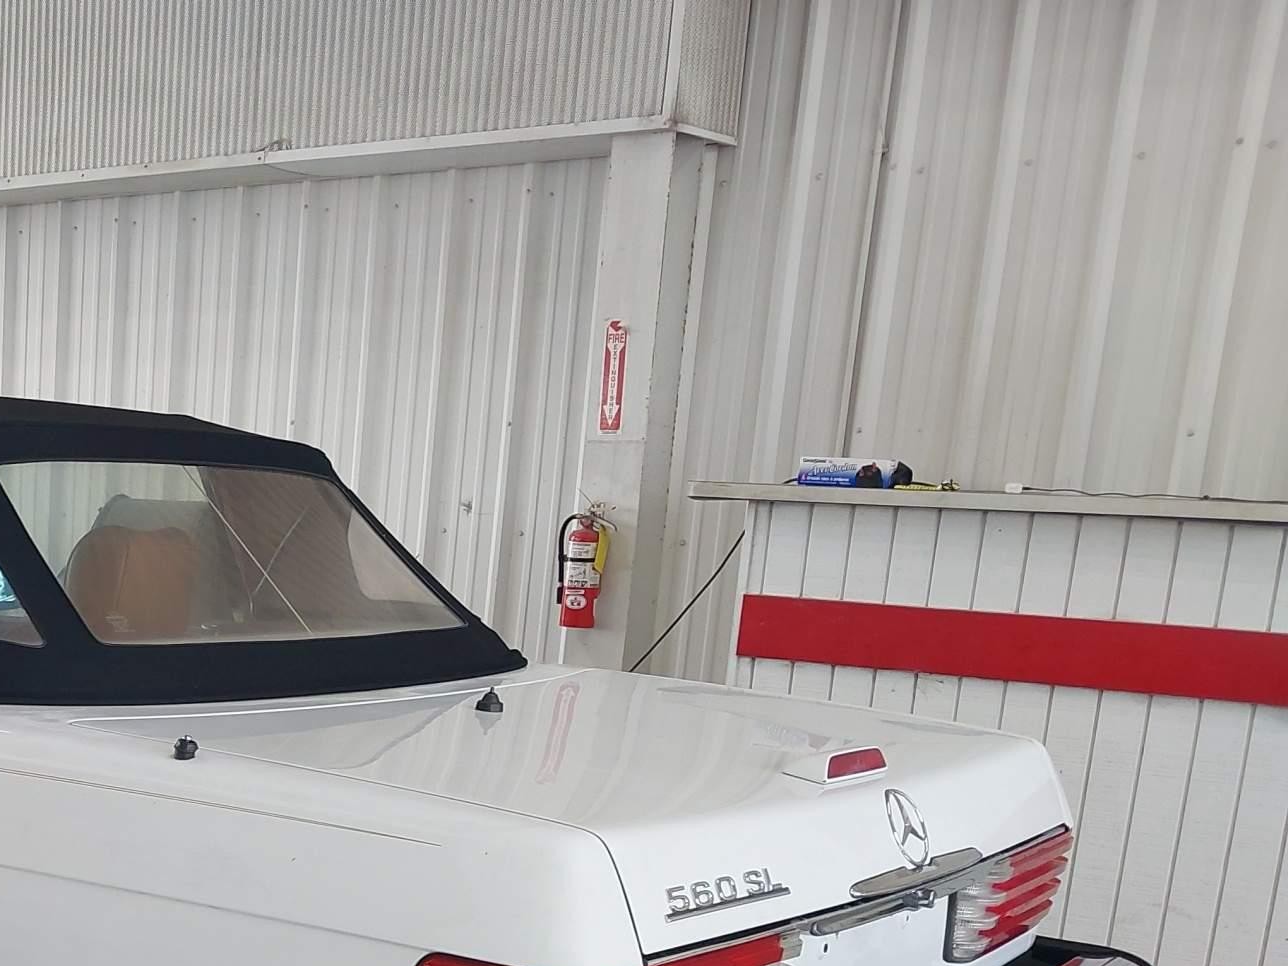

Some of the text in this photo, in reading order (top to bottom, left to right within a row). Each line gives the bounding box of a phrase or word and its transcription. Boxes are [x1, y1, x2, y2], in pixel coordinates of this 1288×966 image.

[608, 333, 625, 344] FIRE
[608, 344, 618, 420] EXTINGUISHER
[665, 868, 783, 911] 560 SL
